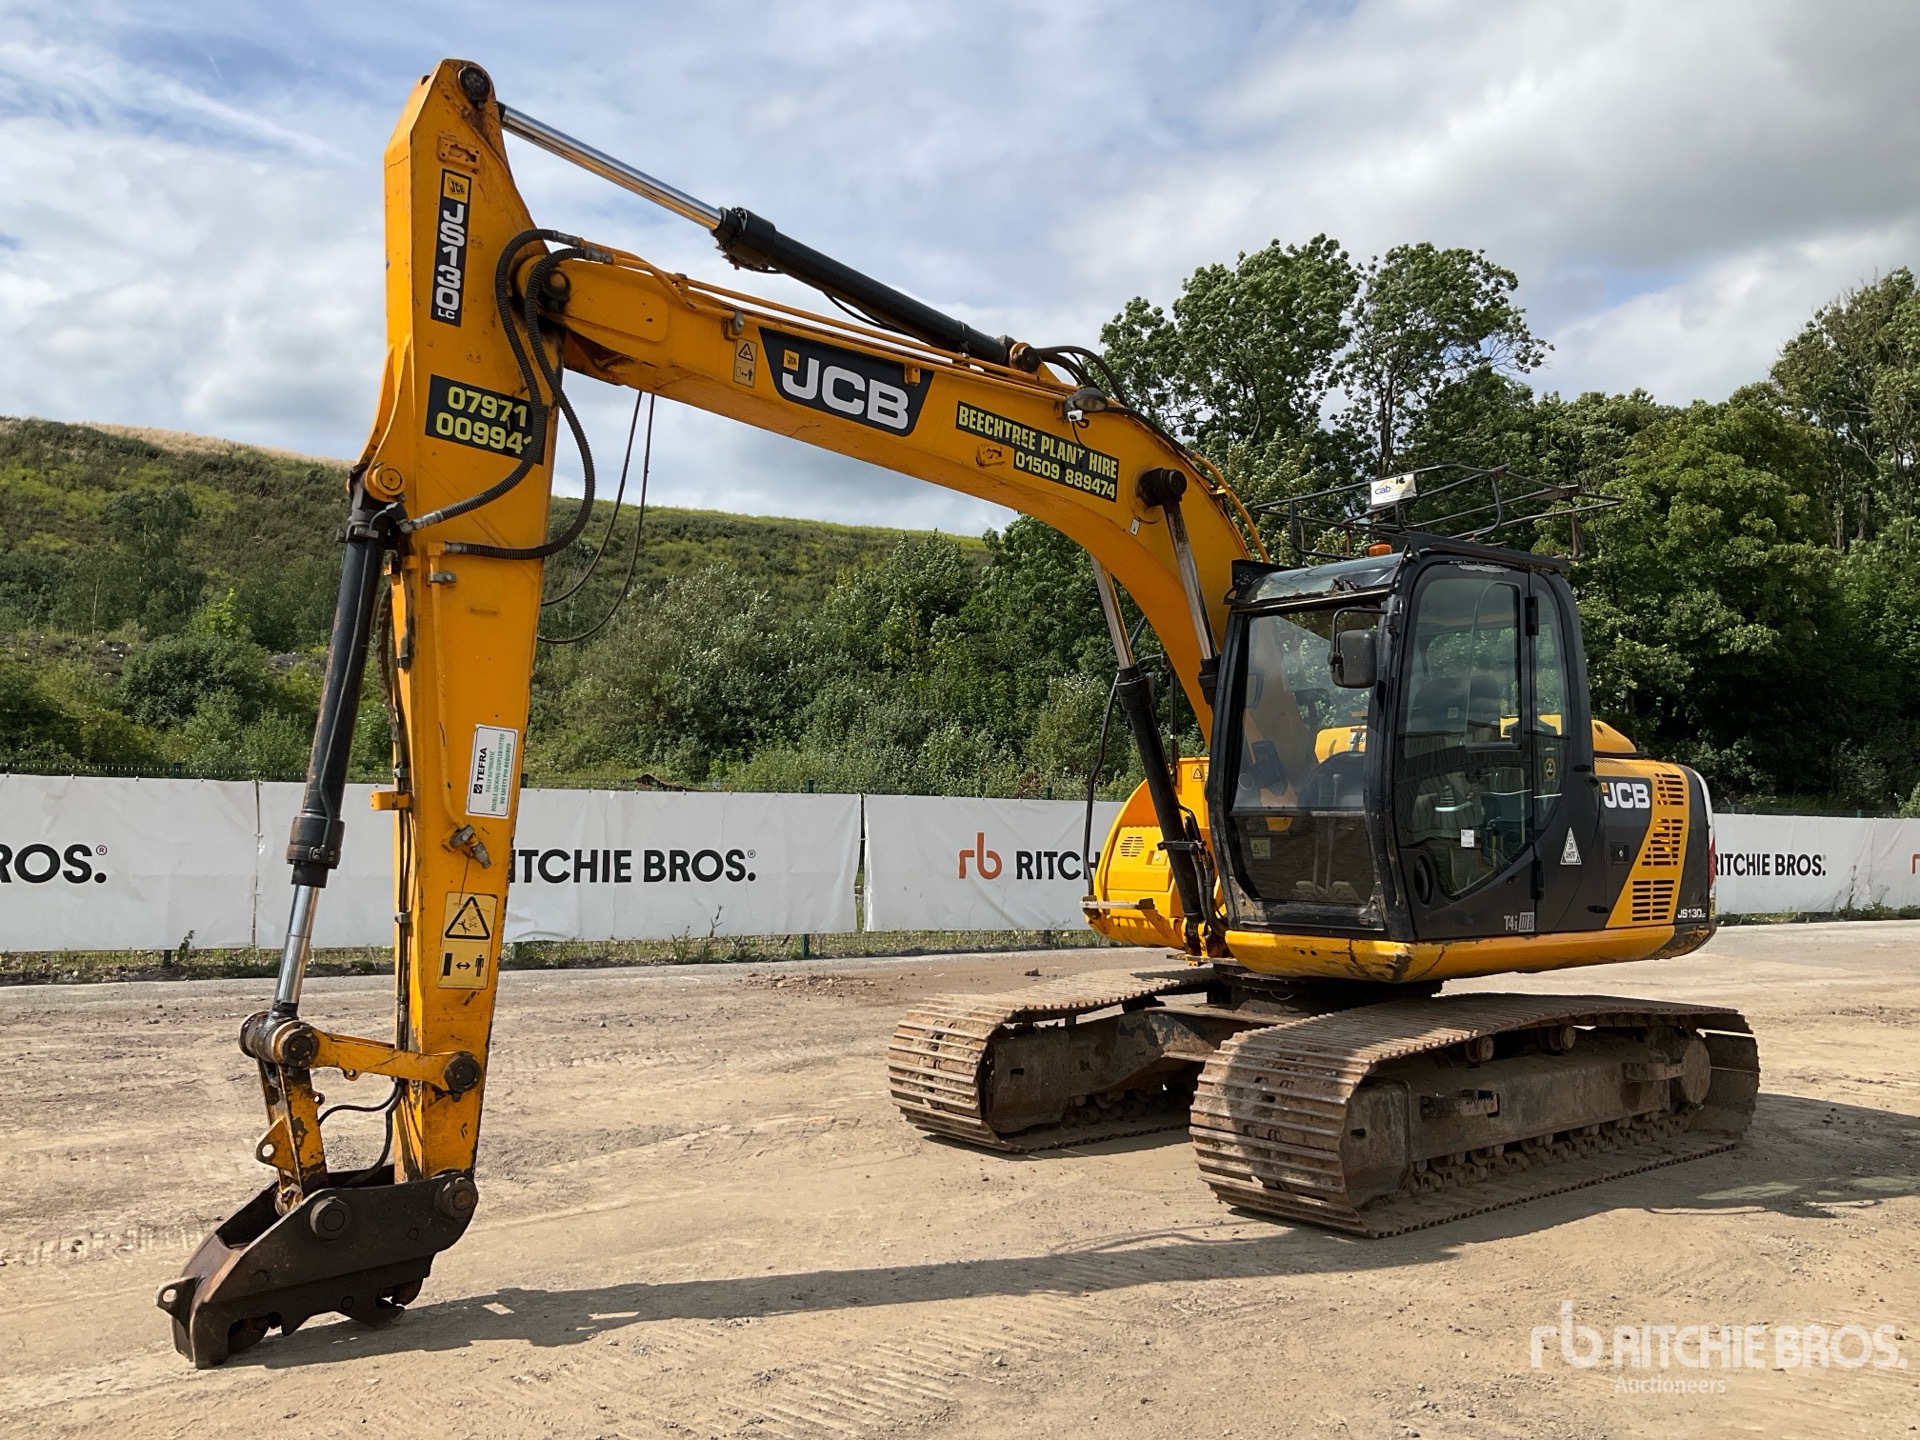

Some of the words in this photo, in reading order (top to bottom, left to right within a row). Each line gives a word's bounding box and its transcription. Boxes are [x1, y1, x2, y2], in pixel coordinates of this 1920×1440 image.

[436, 203, 465, 311] JS130
[437, 308, 456, 320] LC
[447, 386, 527, 427] 07971
[782, 357, 909, 430] JCB
[958, 405, 1036, 450] BEECHTREE
[1040, 434, 1086, 465] PLANT
[1089, 452, 1118, 479] HIRE
[1015, 450, 1060, 480] 01509
[1065, 469, 1116, 499] 889474
[497, 733, 505, 750] FITTED
[476, 747, 488, 782] TEFRA
[487, 750, 495, 778] AUTOMATIC
[495, 750, 503, 771] COUPLER
[500, 796, 506, 805] NO
[503, 743, 511, 768] REQUIRED
[493, 772, 501, 792] LOCKING
[1603, 782, 1651, 809] JCB
[958, 832, 1003, 881] rb
[1503, 914, 1518, 931] T4i
[1677, 908, 1702, 919] JS130
